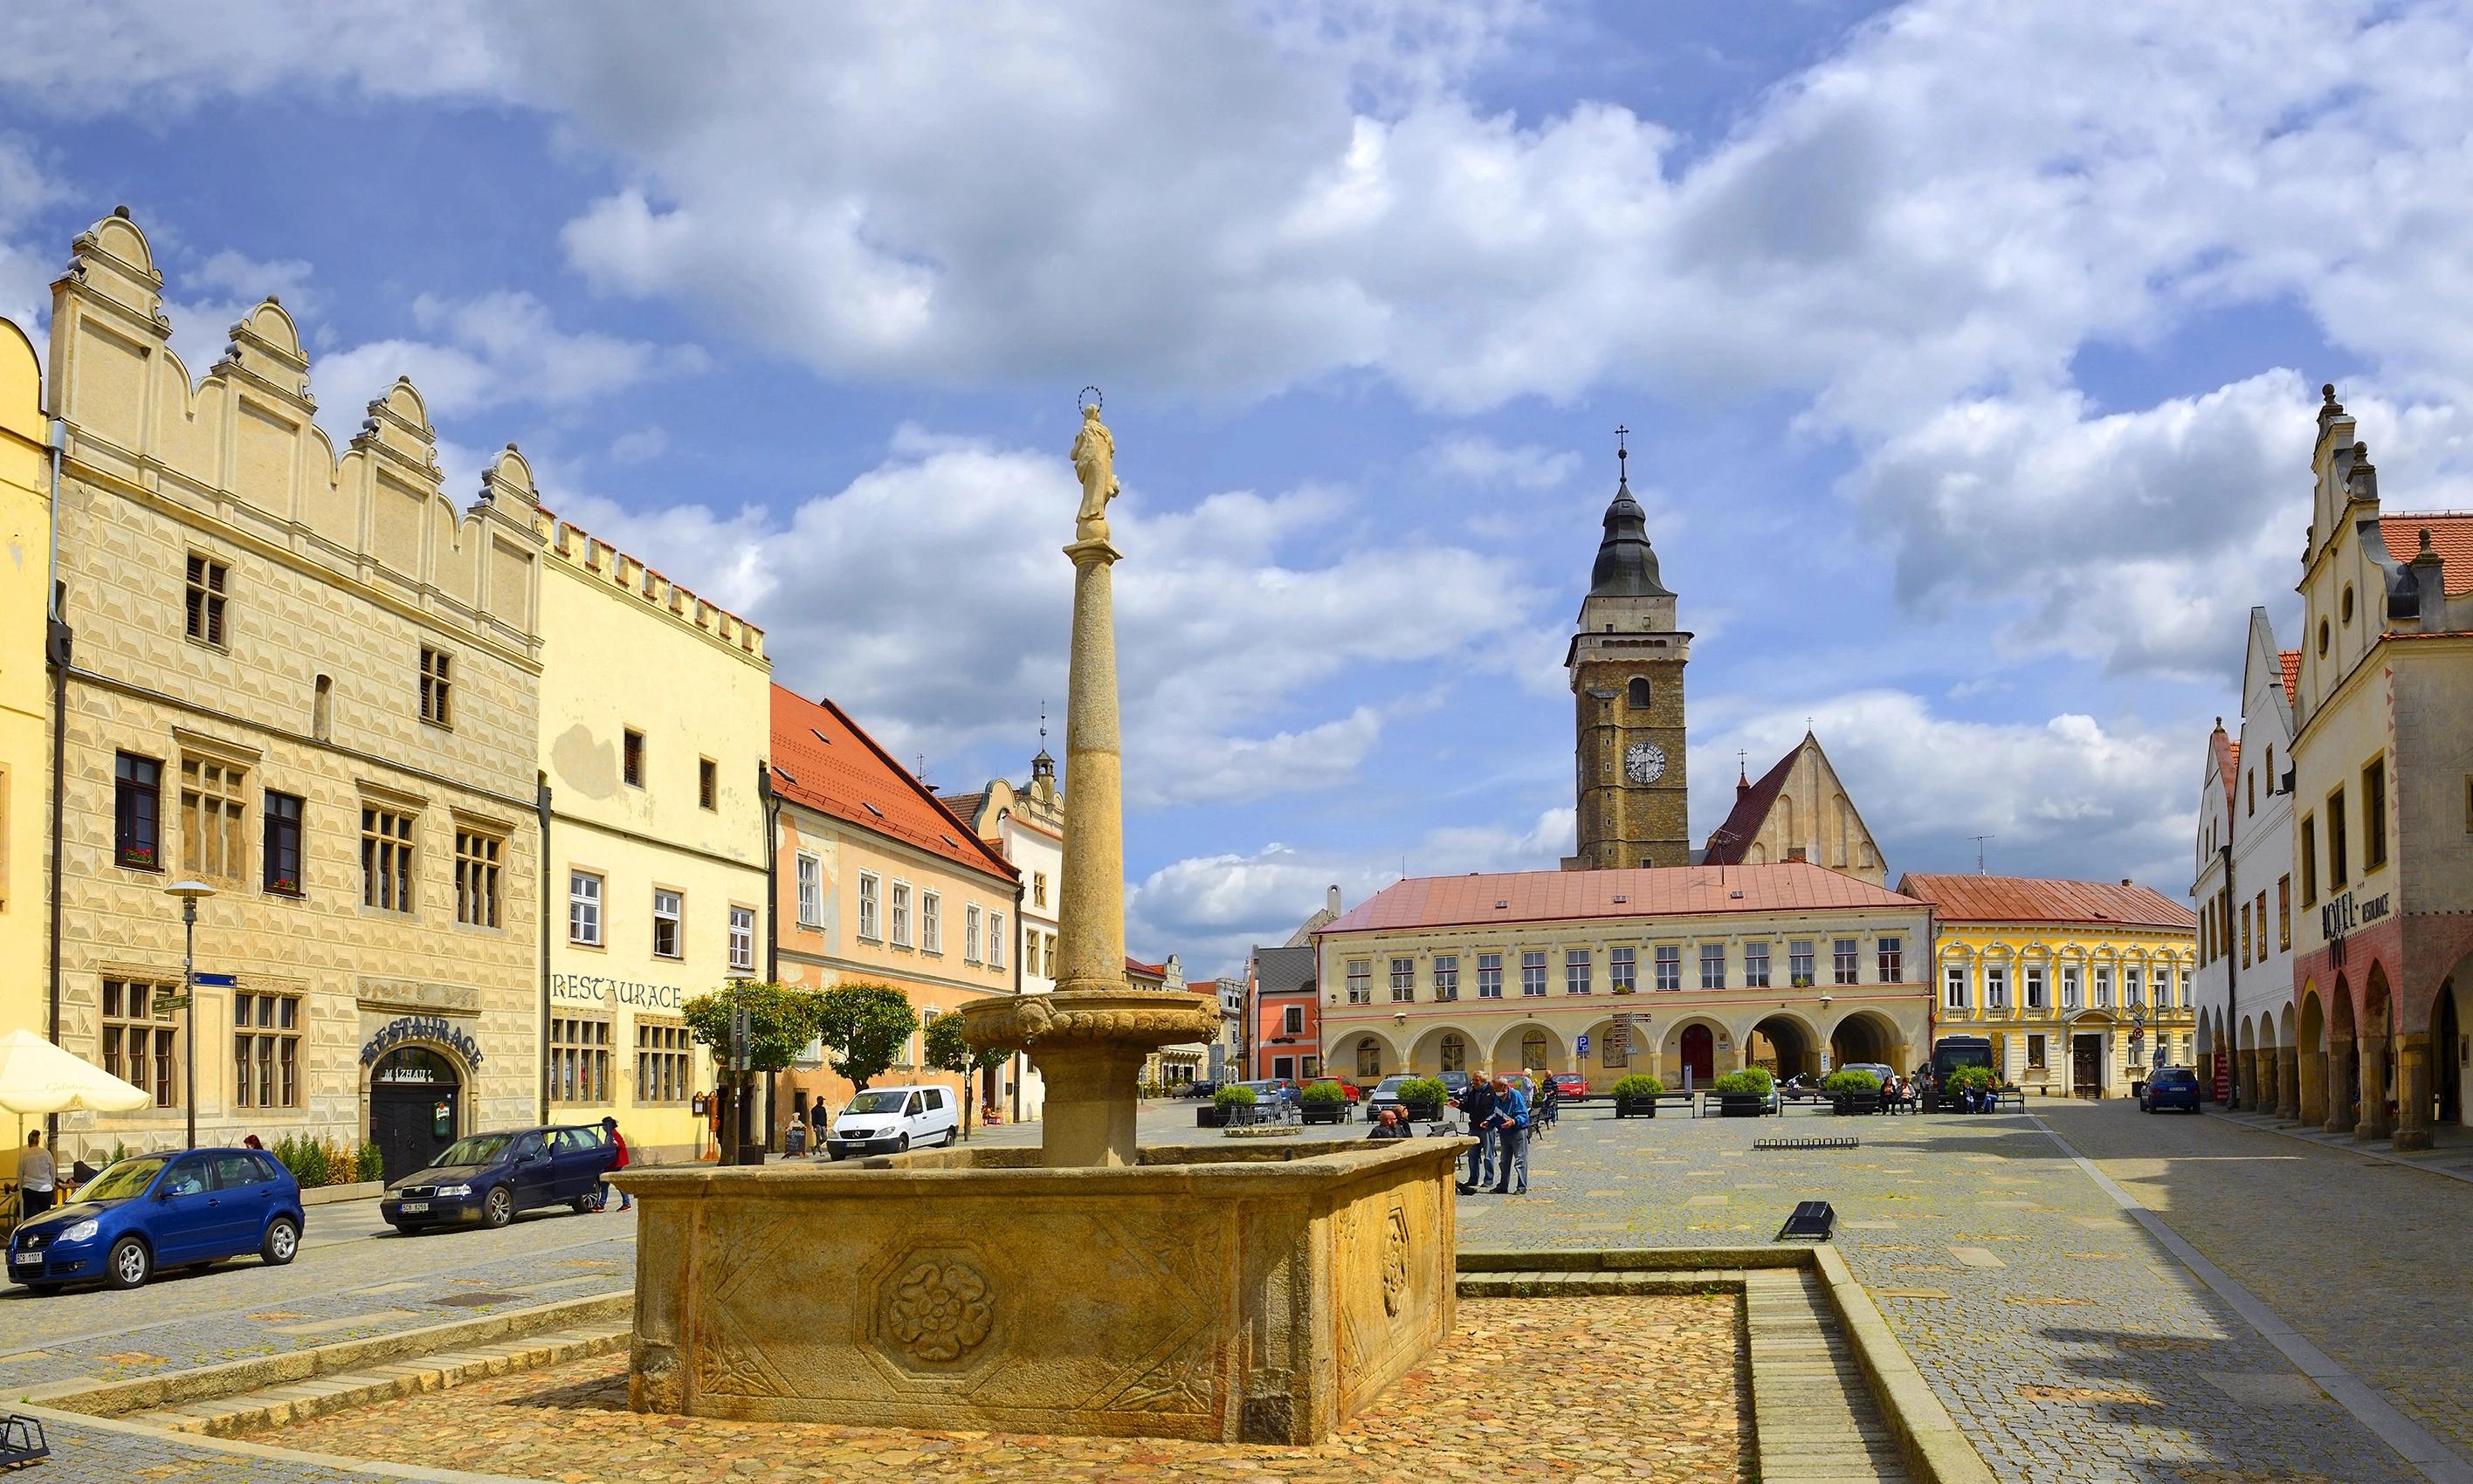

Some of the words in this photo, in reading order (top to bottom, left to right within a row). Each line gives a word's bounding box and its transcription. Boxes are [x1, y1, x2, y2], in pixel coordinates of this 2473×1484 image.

[552, 974, 681, 1009] RESTAURACE
[359, 1015, 484, 1075] RESTAURACE
[1580, 1037, 1587, 1047] P
